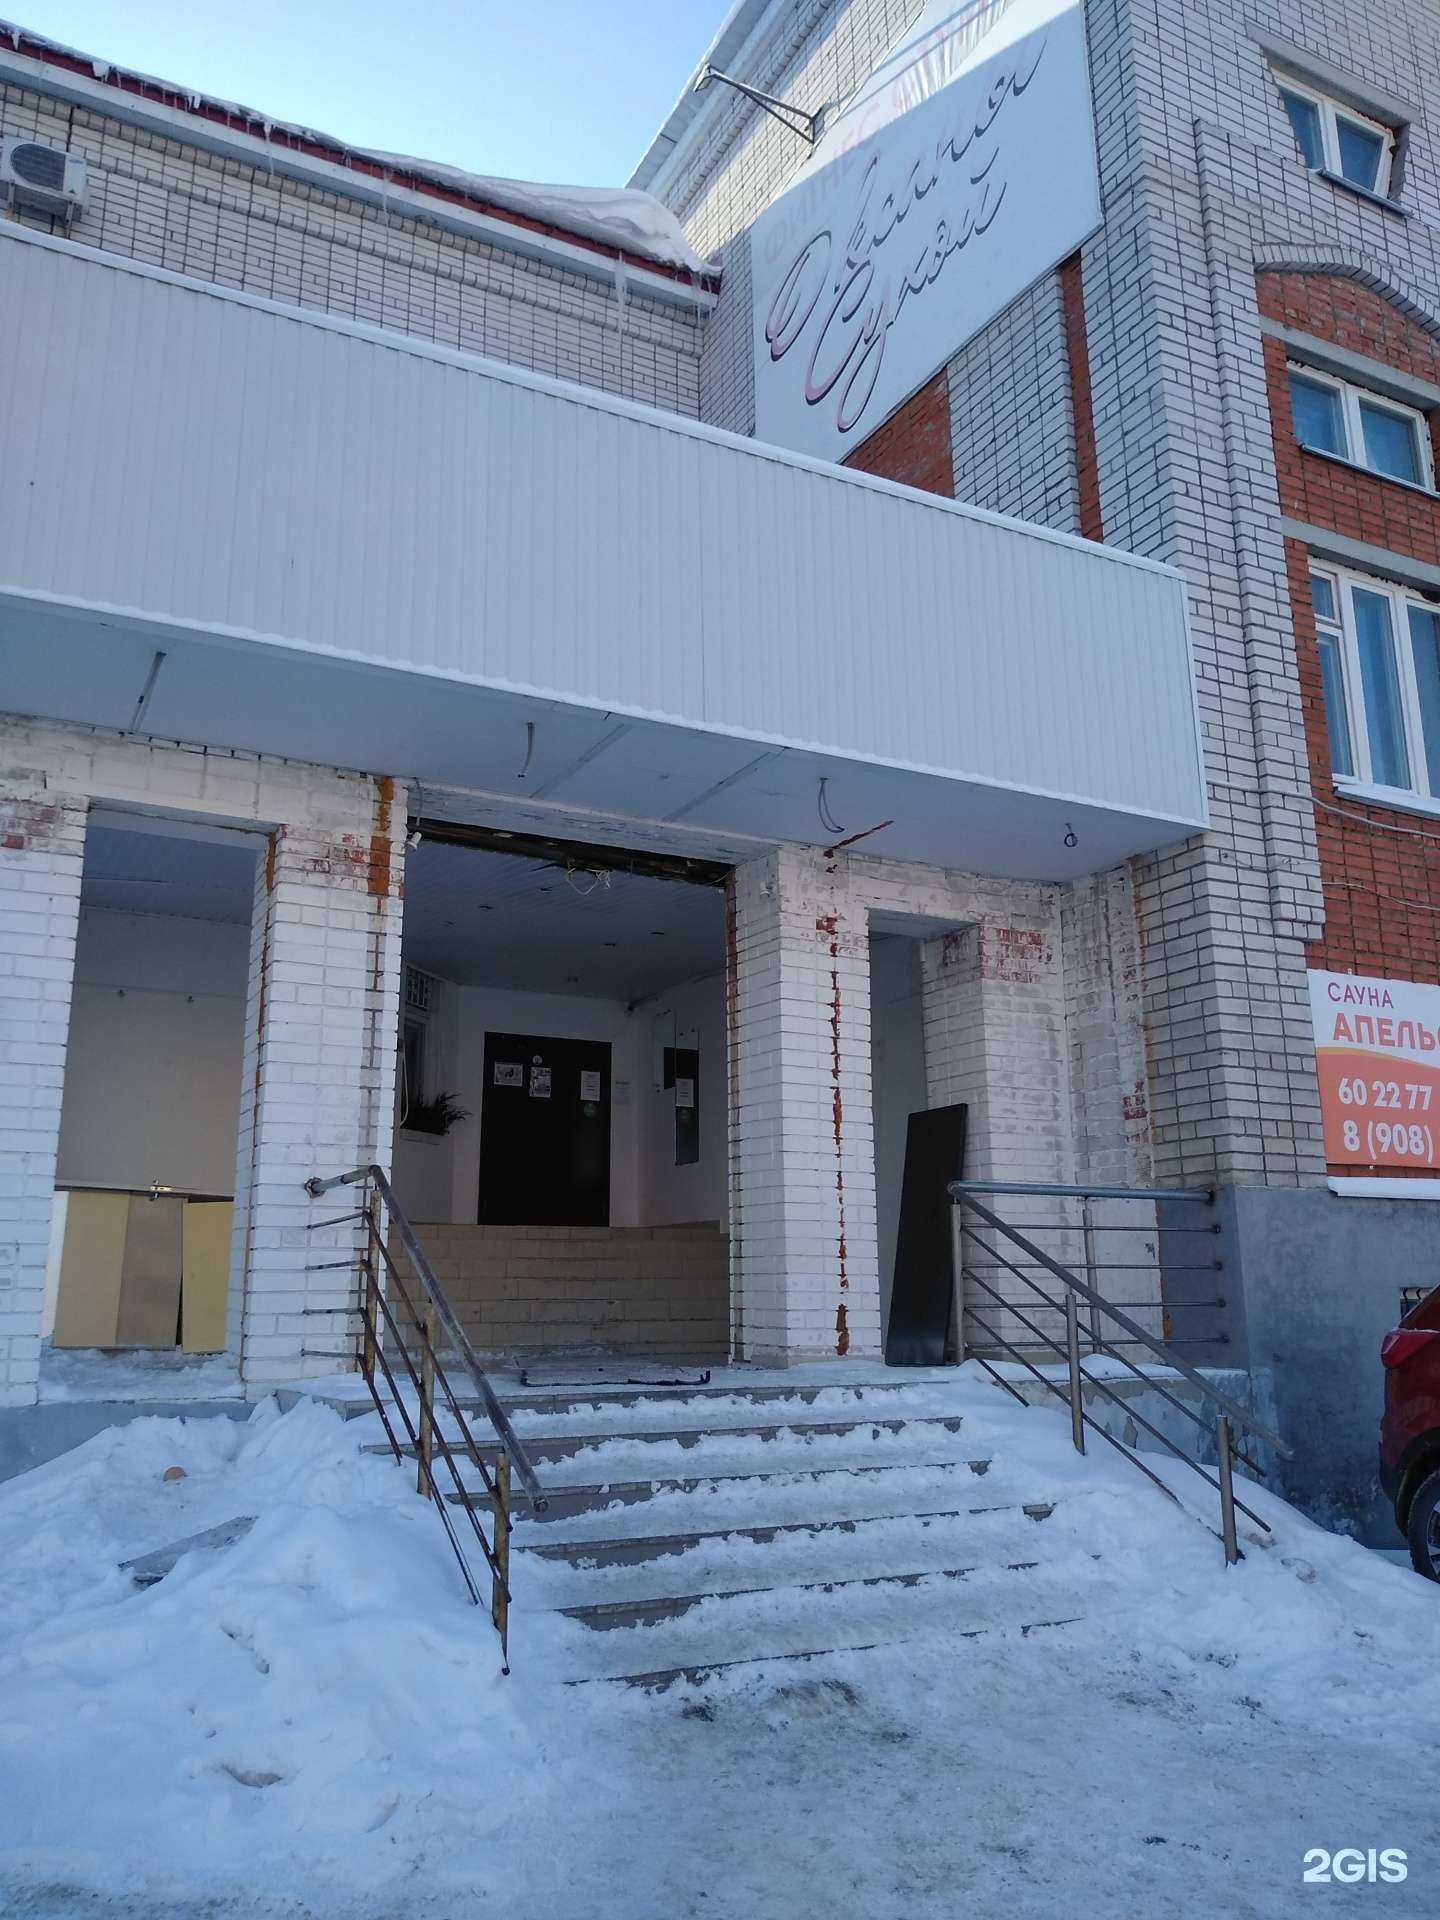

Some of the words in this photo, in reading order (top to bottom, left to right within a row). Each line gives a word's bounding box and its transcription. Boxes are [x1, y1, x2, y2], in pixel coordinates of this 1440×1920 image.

[1327, 982, 1394, 1008] САУНА
[1333, 1012, 1440, 1051] АПЕЛЬ
[1338, 1077, 1367, 1106] 60
[1372, 1080, 1401, 1109] 22
[1405, 1083, 1433, 1111] 77
[1343, 1119, 1361, 1152] 8
[1367, 1120, 1433, 1164] (908)
